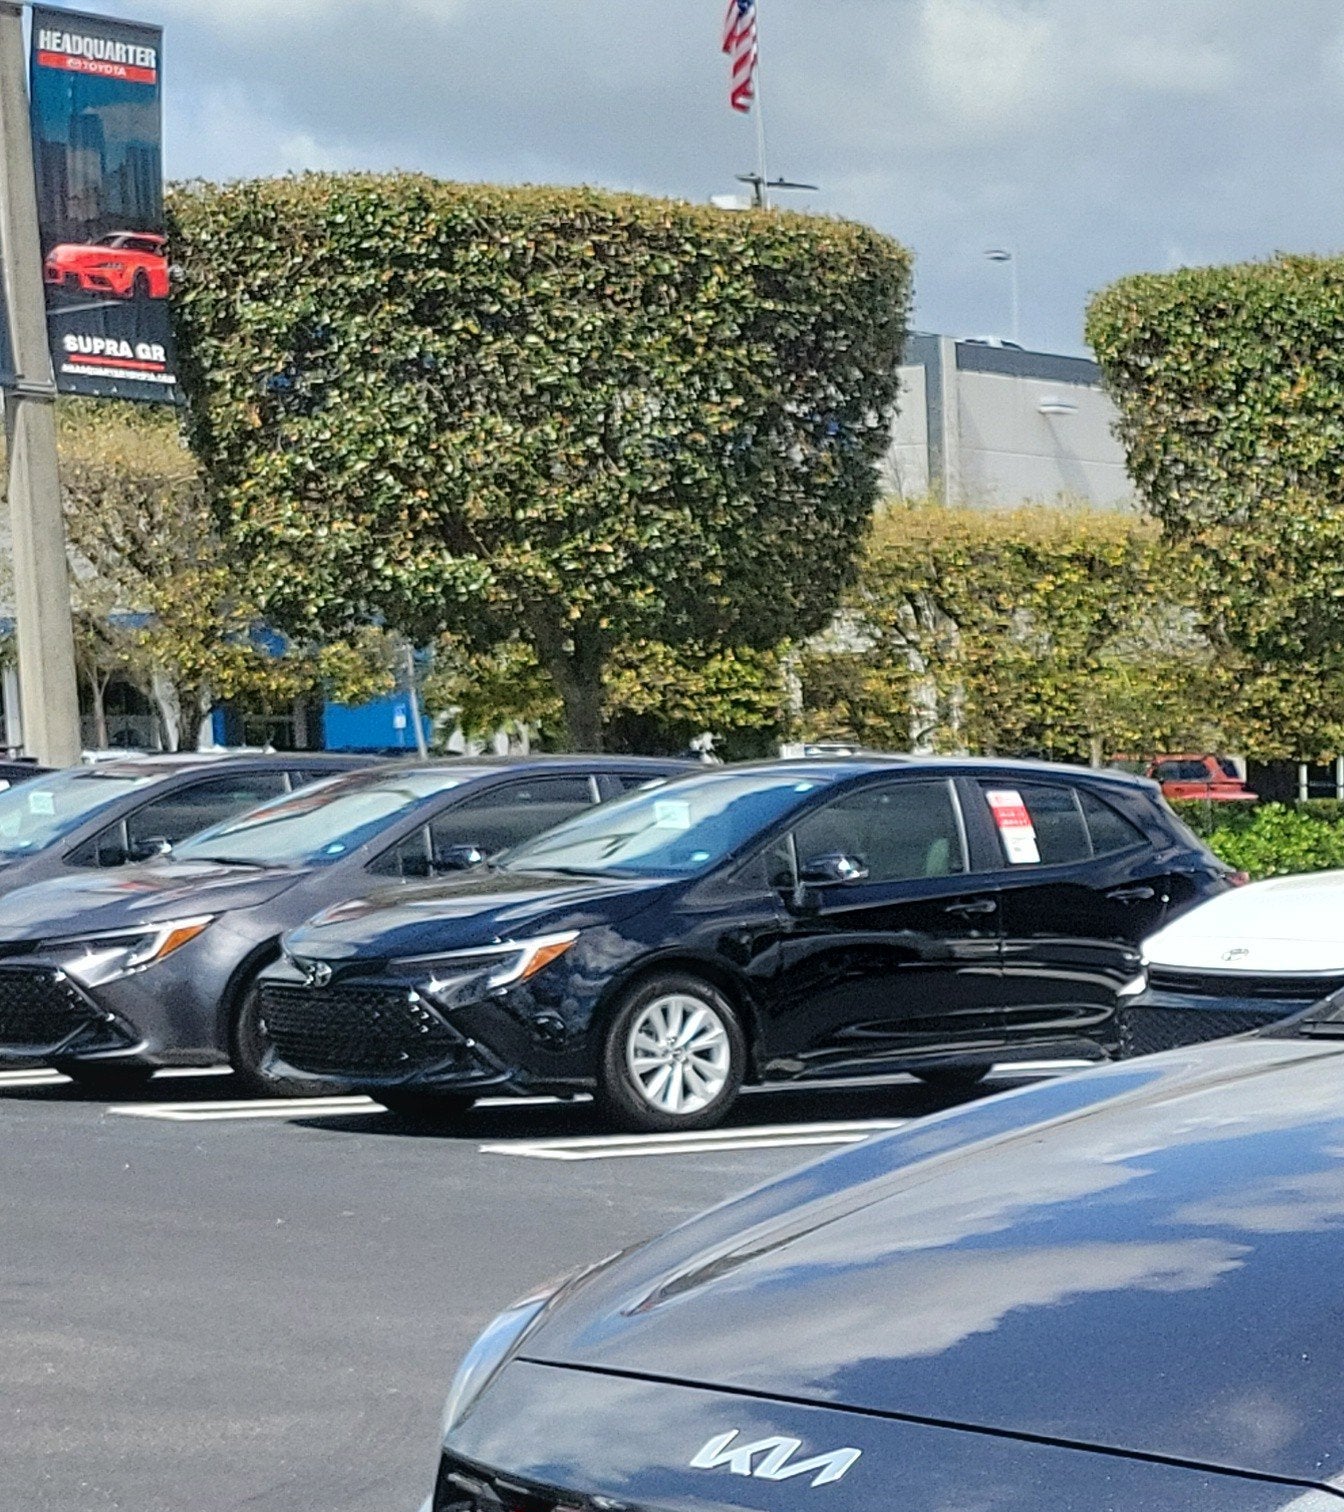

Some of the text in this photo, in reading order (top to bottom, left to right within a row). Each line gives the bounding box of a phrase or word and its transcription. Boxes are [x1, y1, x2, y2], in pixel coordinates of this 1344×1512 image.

[40, 29, 156, 68] HEADQUARTER
[83, 60, 126, 76] TOYOTA
[64, 334, 166, 362] SUPRA GR
[690, 1429, 862, 1488] KIA
